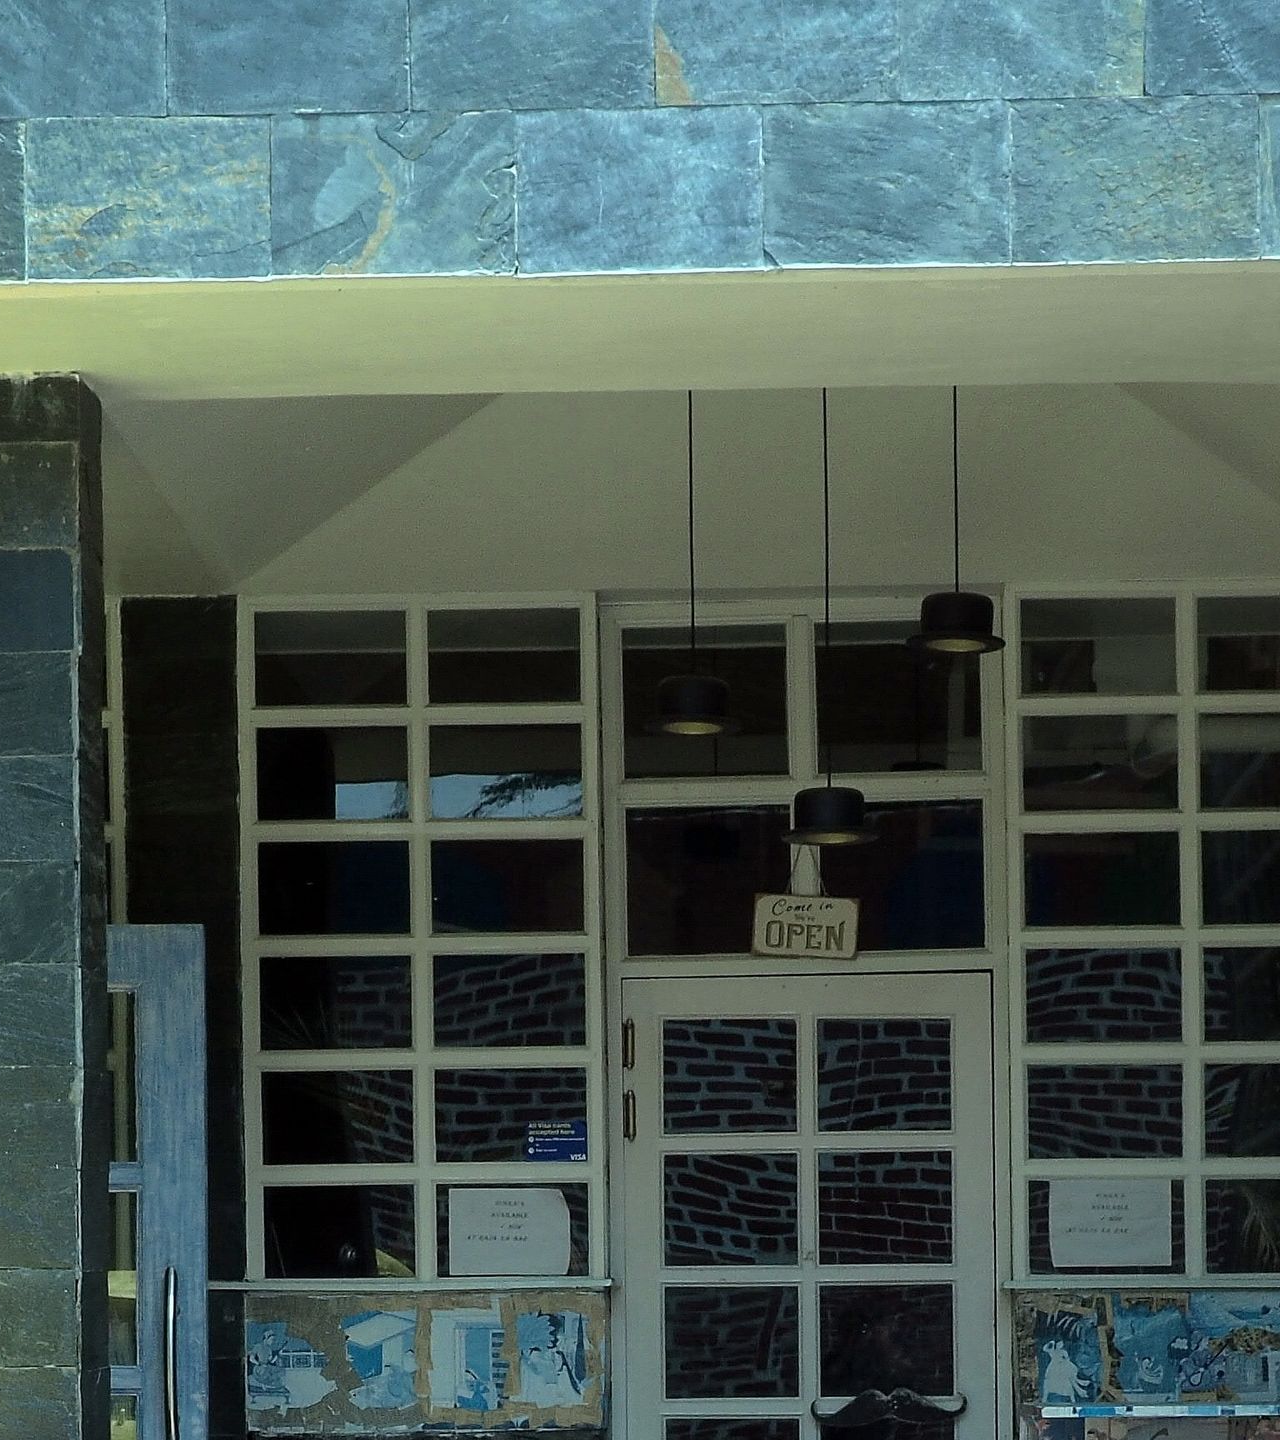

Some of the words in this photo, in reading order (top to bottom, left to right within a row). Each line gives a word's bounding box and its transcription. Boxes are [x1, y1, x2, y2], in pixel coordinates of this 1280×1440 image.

[772, 898, 812, 916] Come
[820, 901, 833, 911] in
[765, 920, 846, 951] OPEN
